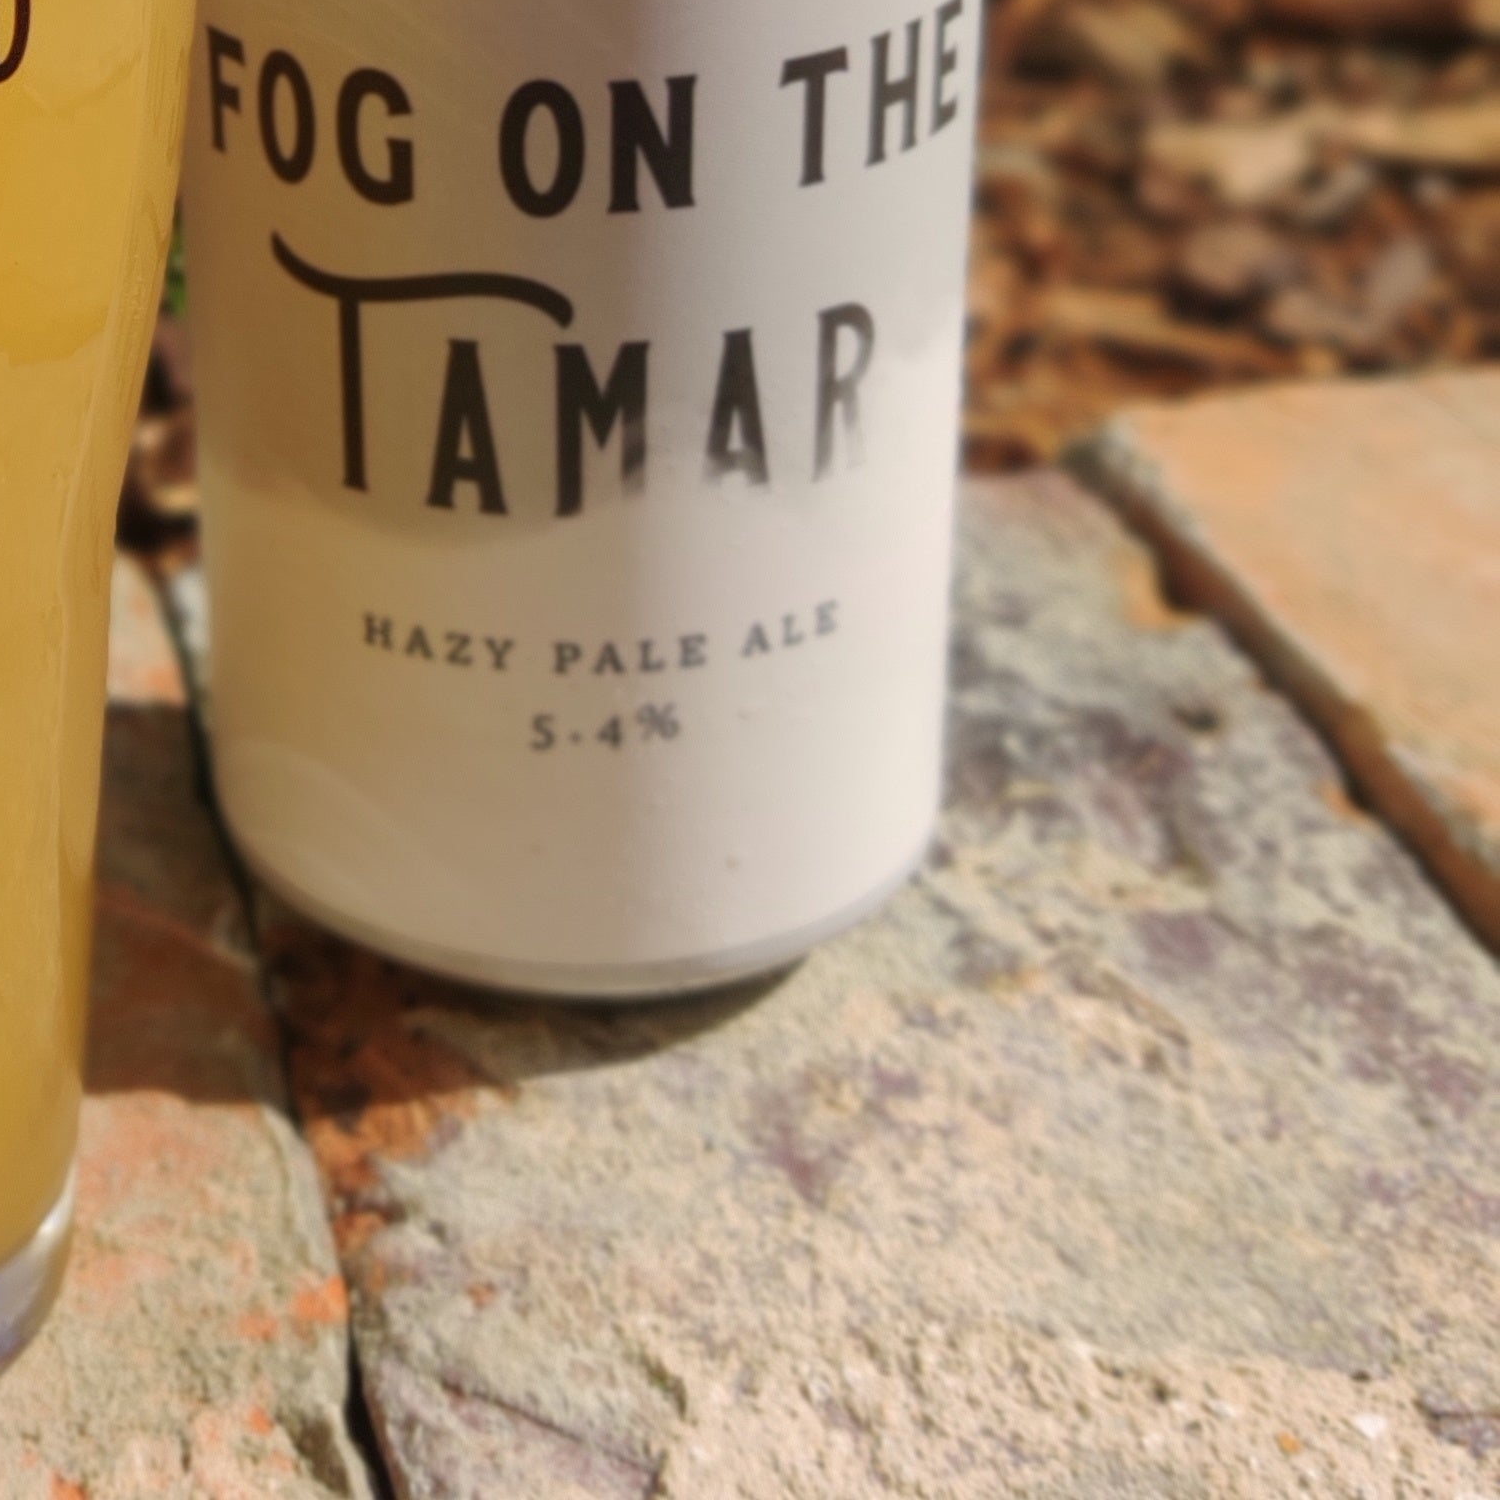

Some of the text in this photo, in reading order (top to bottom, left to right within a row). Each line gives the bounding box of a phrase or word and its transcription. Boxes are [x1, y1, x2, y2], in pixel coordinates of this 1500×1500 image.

[205, 23, 416, 206] FOG
[499, 73, 698, 219] ON
[270, 229, 876, 518] TAMAR
[363, 600, 841, 676] HAZY PALE ALE
